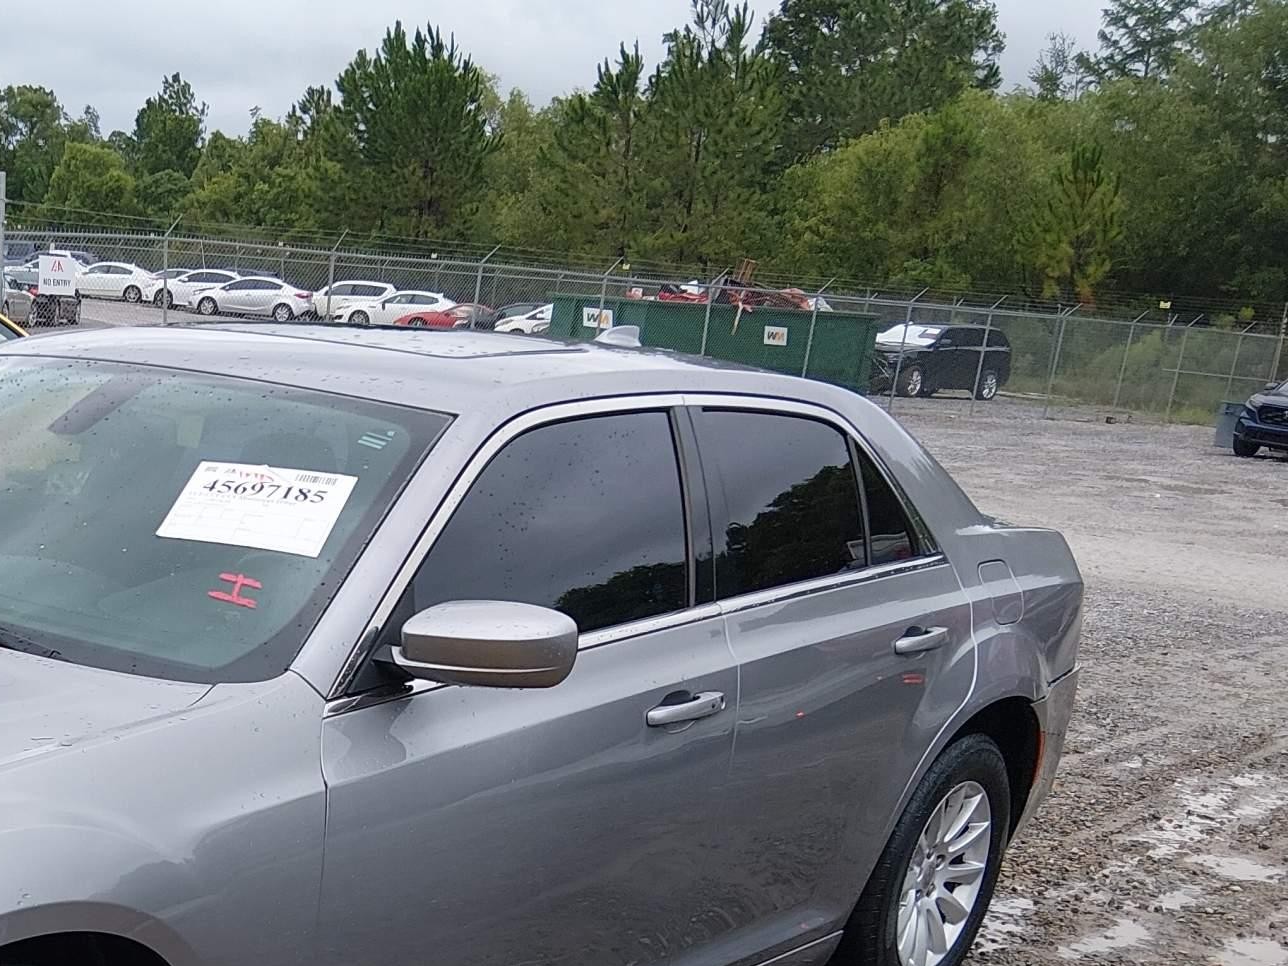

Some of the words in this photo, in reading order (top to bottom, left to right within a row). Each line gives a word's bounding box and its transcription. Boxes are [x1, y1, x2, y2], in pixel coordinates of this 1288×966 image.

[43, 278, 52, 287] NO
[53, 279, 72, 288] ENTRY
[767, 331, 785, 342] WM
[202, 479, 328, 504] 45697185
